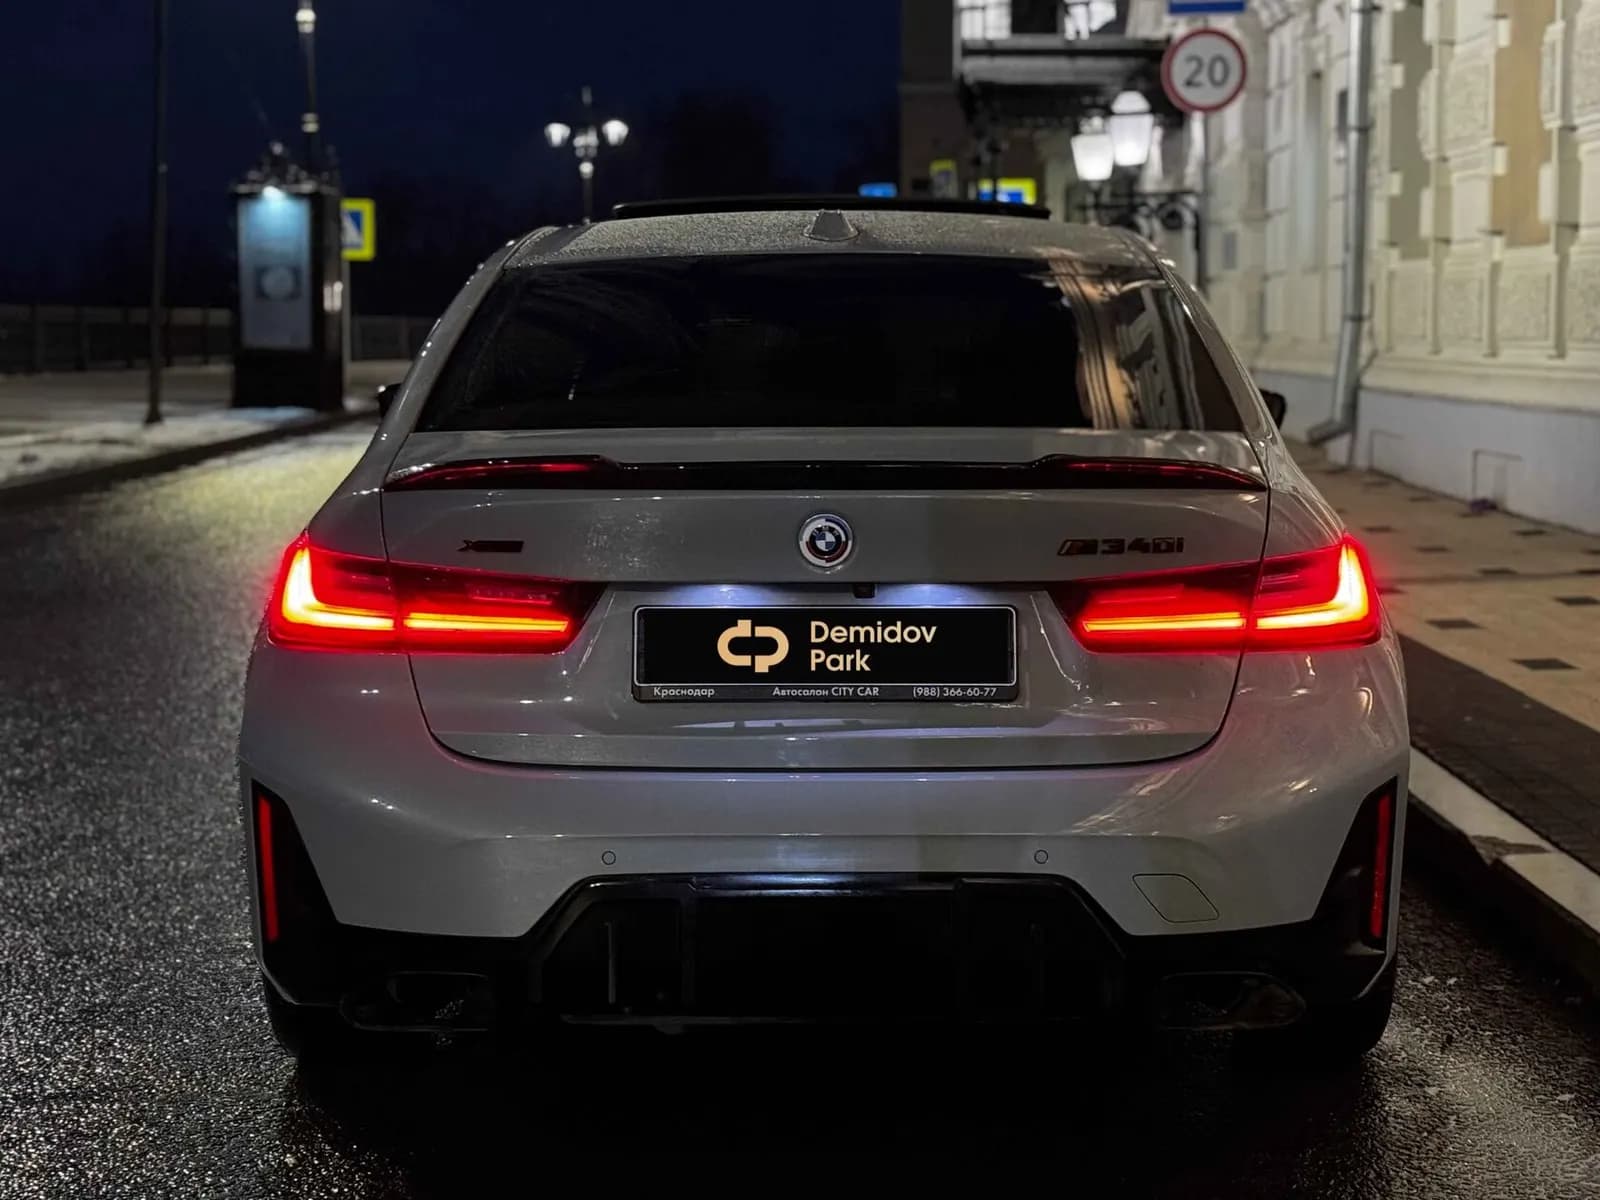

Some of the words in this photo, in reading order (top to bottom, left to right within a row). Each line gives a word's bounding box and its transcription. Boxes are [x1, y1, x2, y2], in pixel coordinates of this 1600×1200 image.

[1183, 54, 1231, 89] 20
[653, 686, 715, 698] Краснодар
[772, 686, 829, 697] Автосалон
[831, 686, 854, 697] CITY
[857, 686, 880, 697] CAR
[913, 686, 940, 698] (988)
[943, 687, 997, 697] 366-60-77
